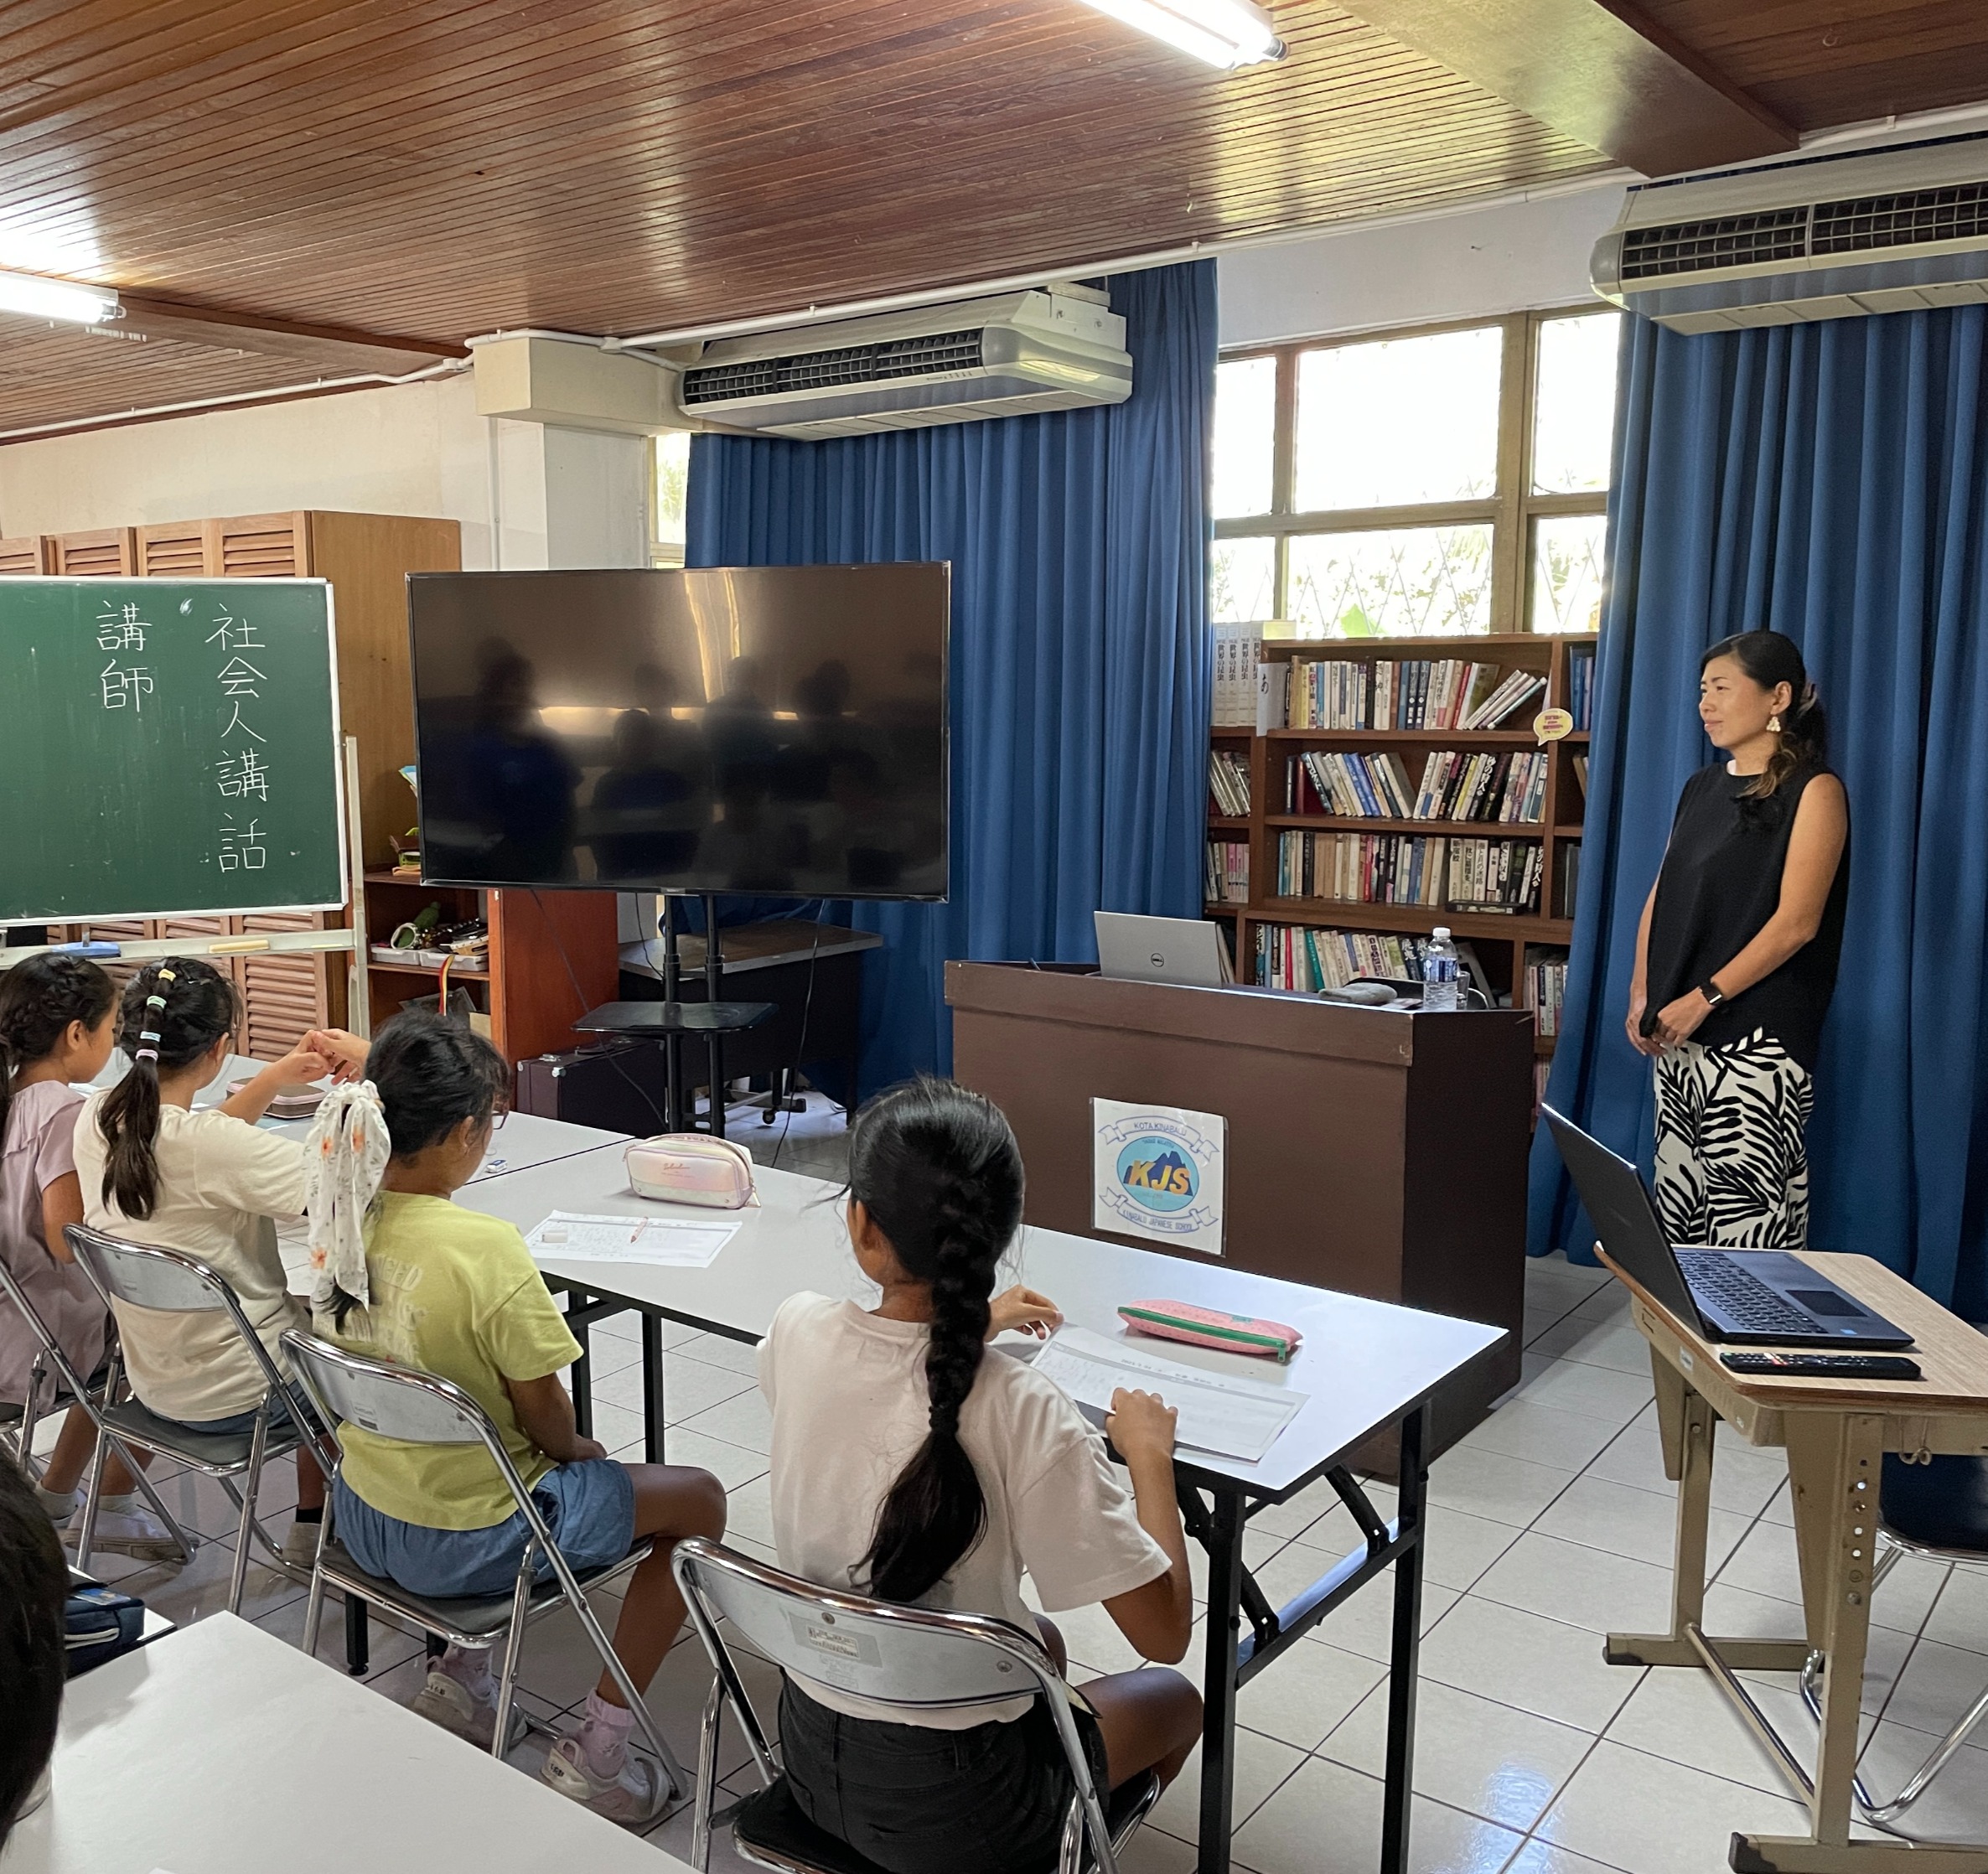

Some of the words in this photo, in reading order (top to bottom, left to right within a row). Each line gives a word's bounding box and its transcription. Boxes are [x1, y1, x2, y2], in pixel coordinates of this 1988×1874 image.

[96, 599, 154, 713] 講師
[204, 603, 270, 873] 社会人講話
[1154, 1123, 1187, 1136] KINABALU
[1128, 1160, 1190, 1195] KJS
